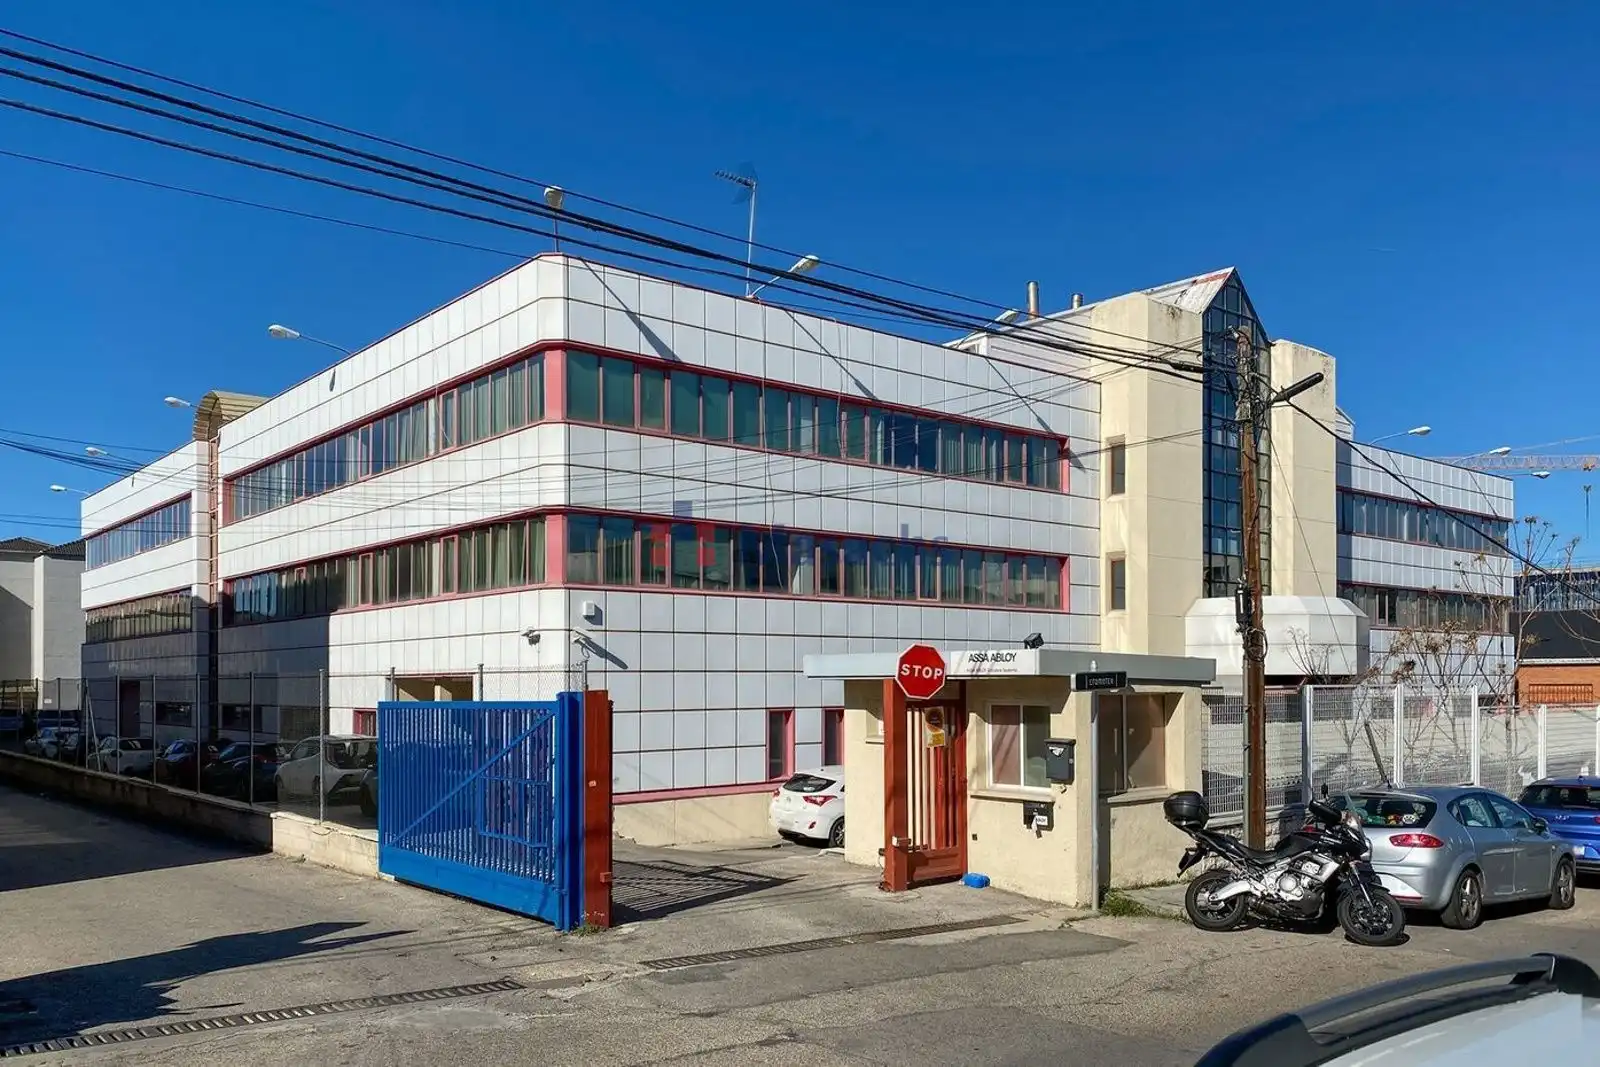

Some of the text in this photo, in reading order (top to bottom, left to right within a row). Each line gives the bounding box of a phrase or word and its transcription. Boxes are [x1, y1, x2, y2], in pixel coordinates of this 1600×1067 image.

[968, 652, 1017, 663] ASSA ABLOY
[900, 663, 943, 680] STOP
